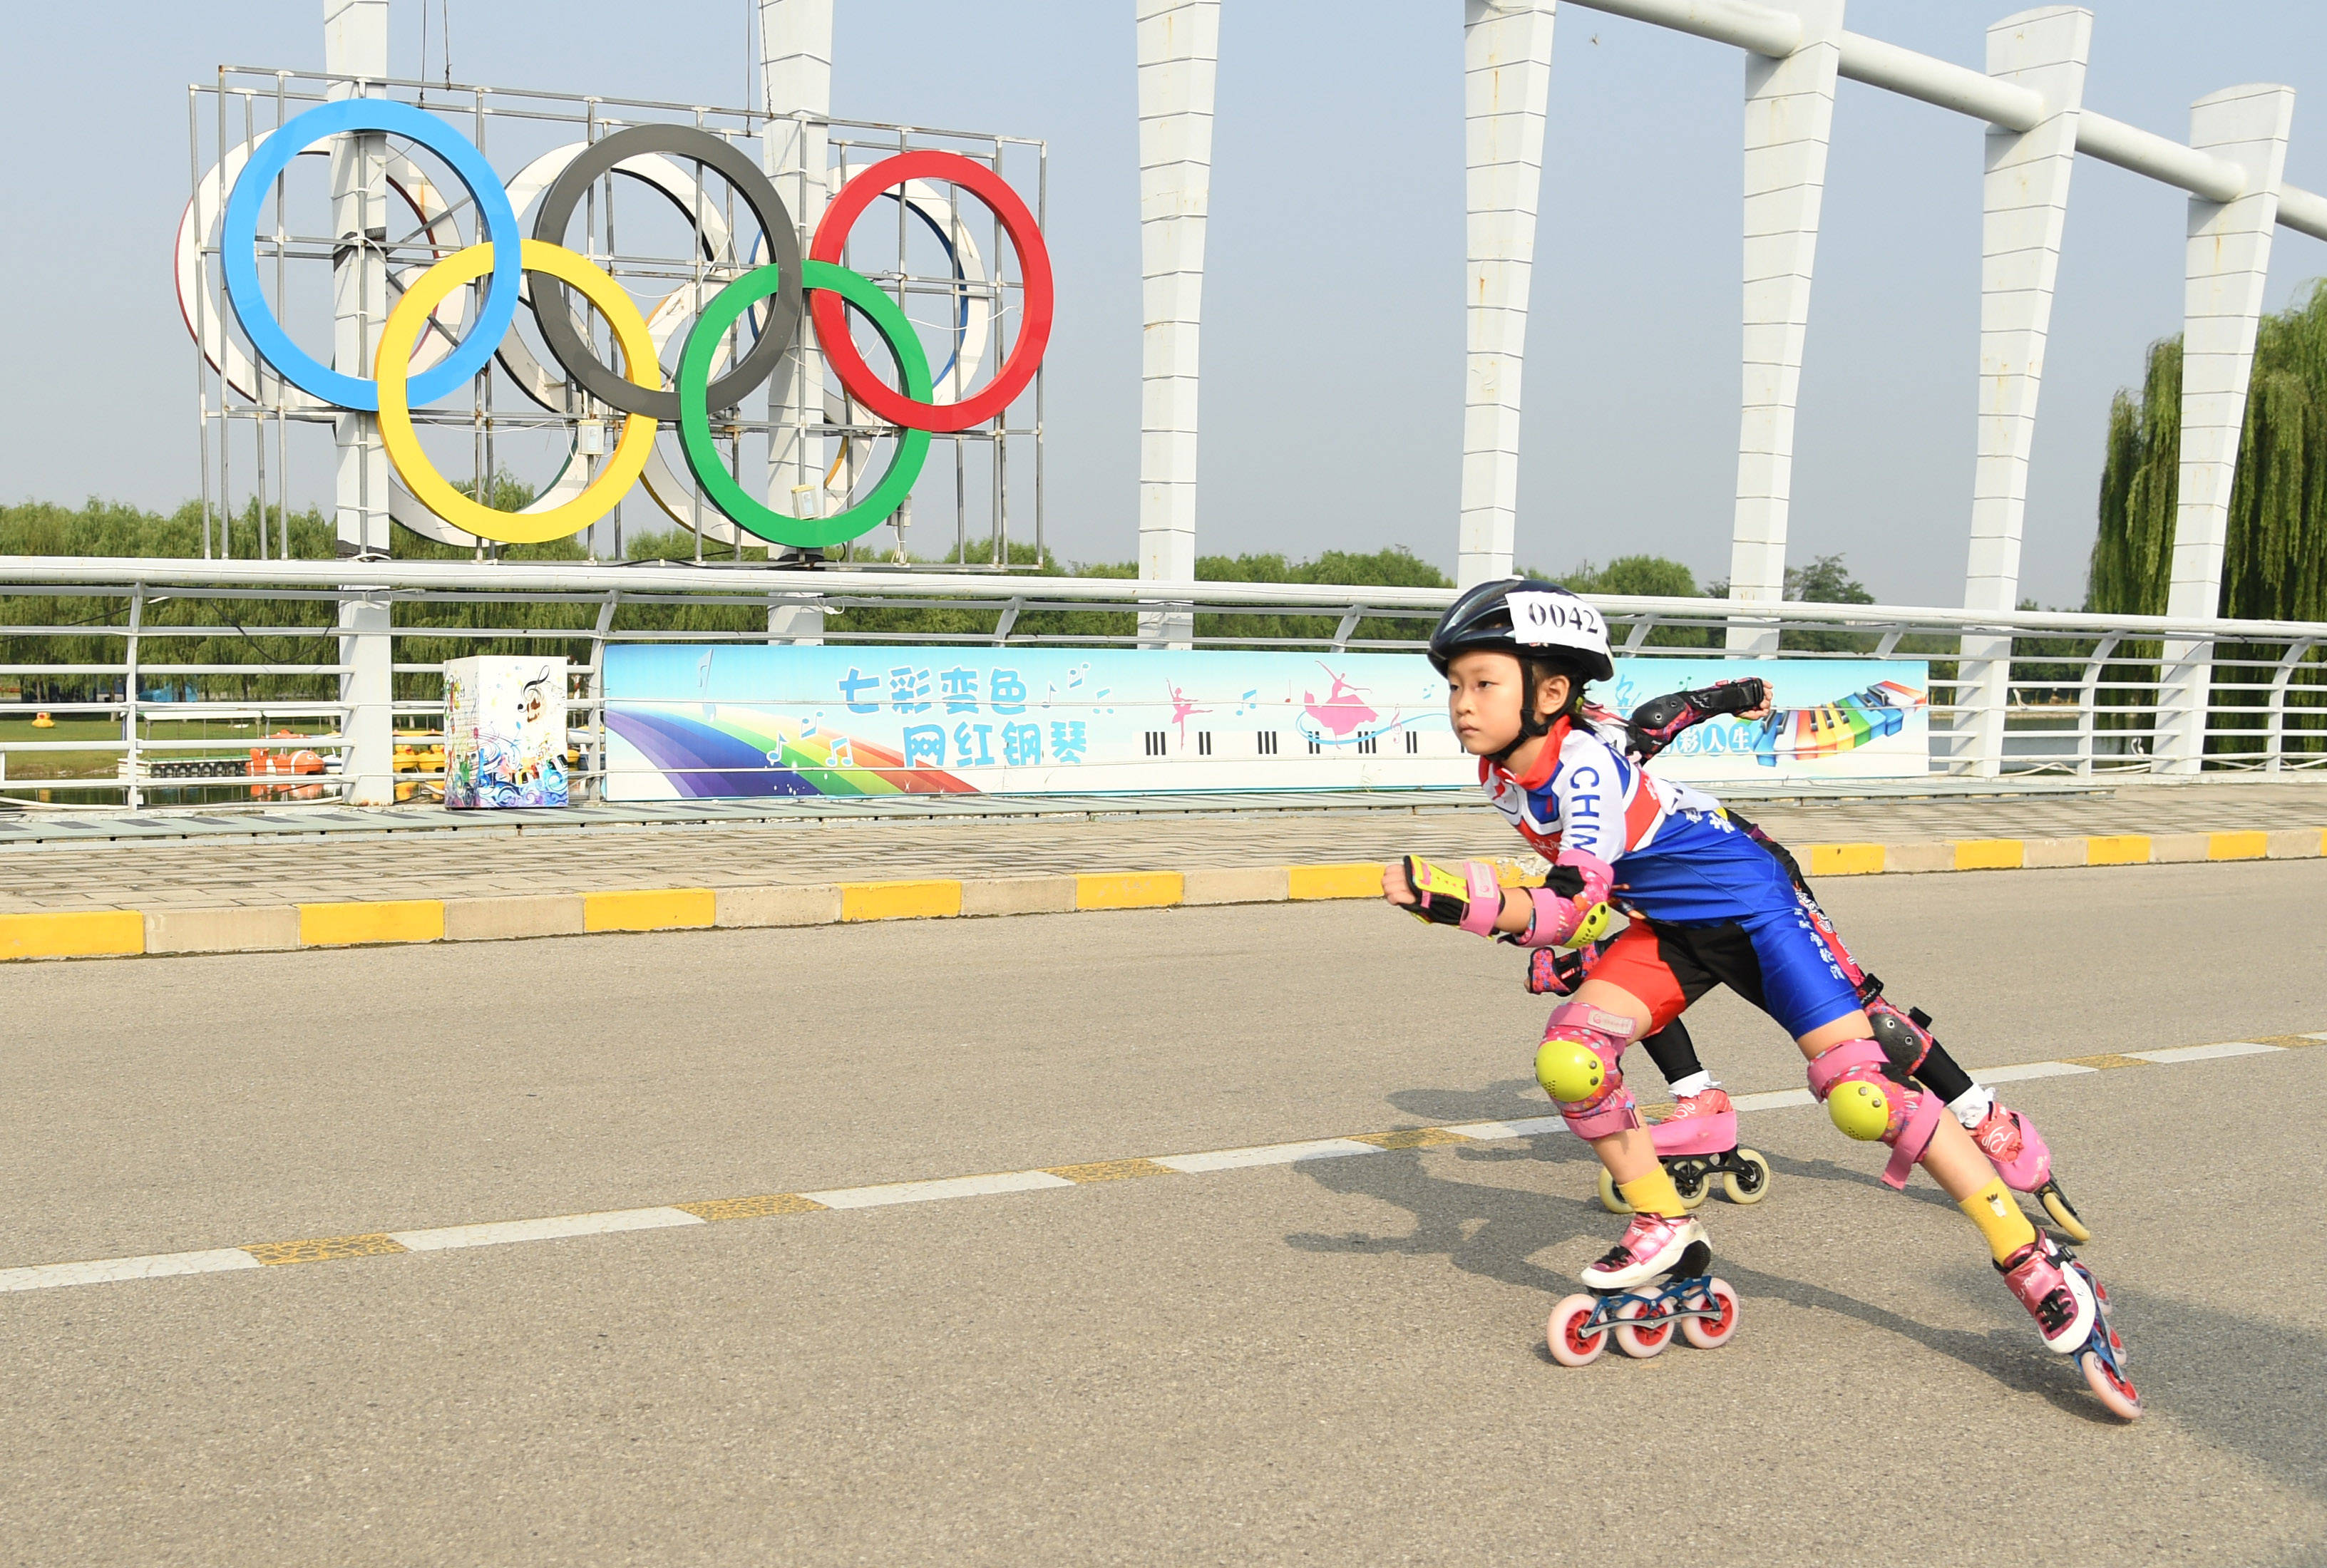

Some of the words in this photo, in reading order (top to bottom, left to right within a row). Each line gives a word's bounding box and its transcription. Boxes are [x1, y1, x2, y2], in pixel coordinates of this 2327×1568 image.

[1528, 602, 1599, 634] 0042
[838, 666, 1027, 714] 七彩变色
[903, 721, 1087, 768] 网红钢琴
[1658, 726, 1751, 755] 彩人生
